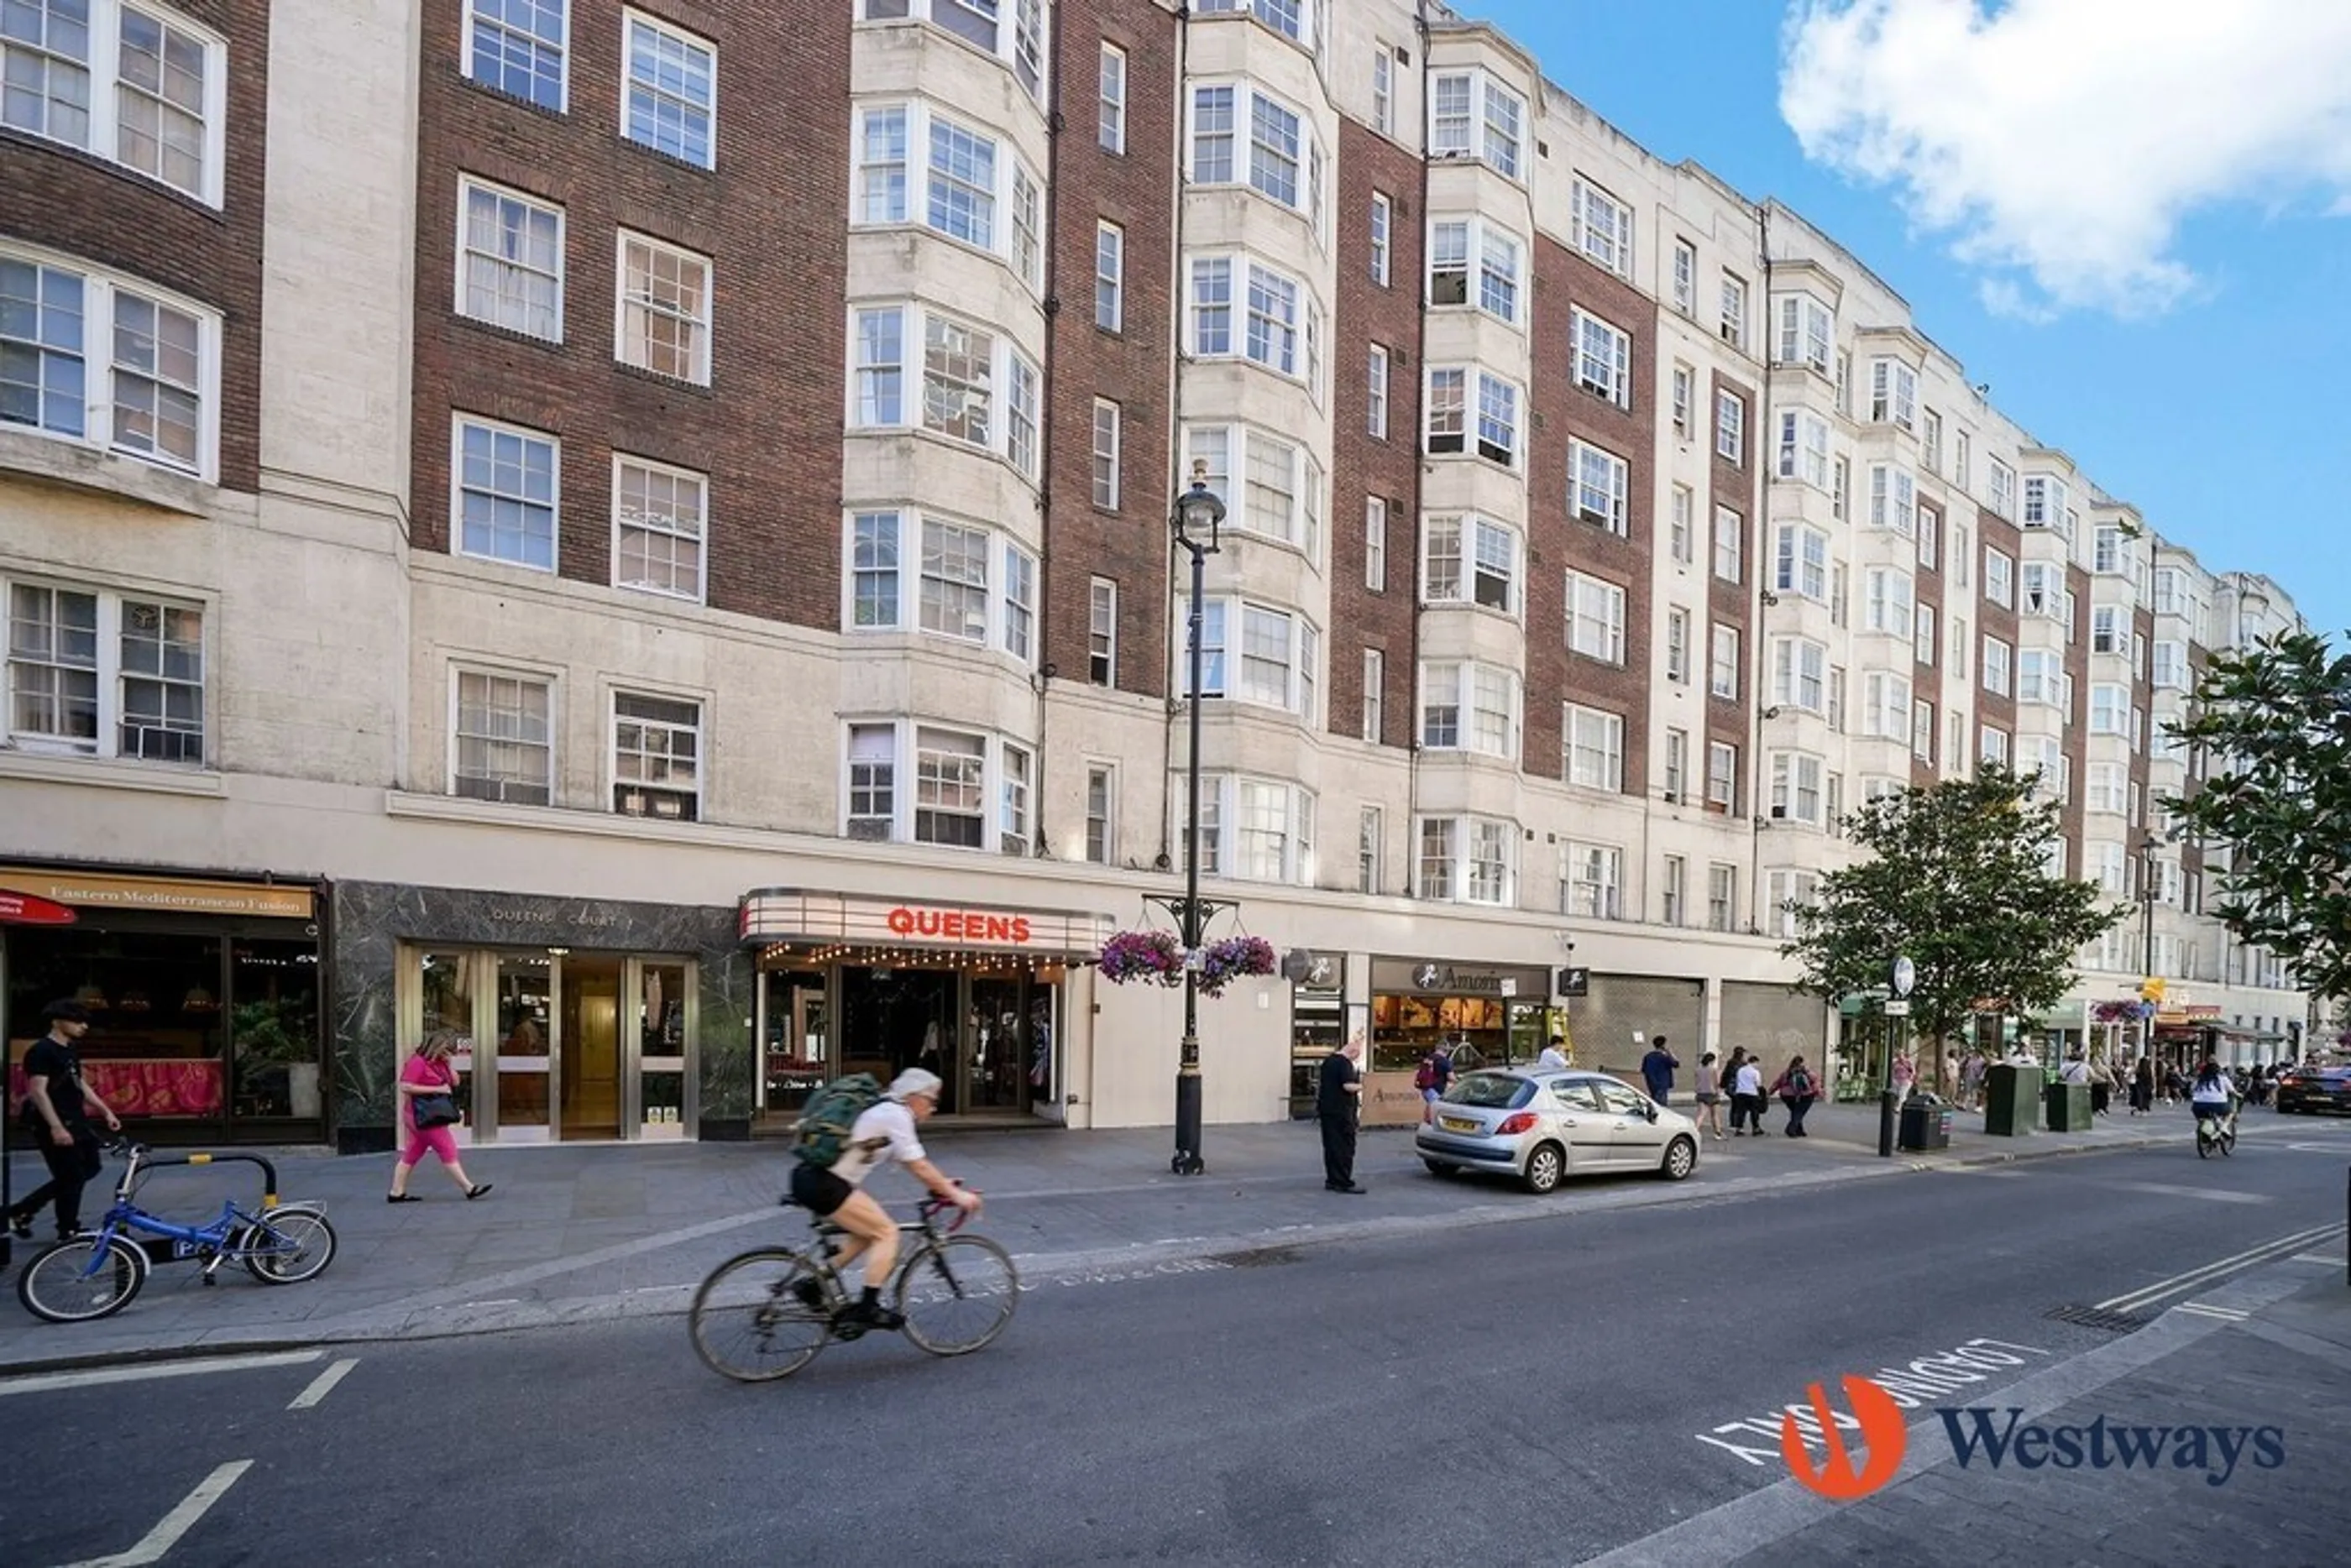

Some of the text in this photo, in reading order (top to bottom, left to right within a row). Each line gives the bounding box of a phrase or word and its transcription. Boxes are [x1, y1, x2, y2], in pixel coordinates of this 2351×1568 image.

[50, 886, 301, 912] Eastern Mediterranean Fusion
[888, 908, 1030, 942] QUEENS
[1439, 966, 1503, 990] Amorin
